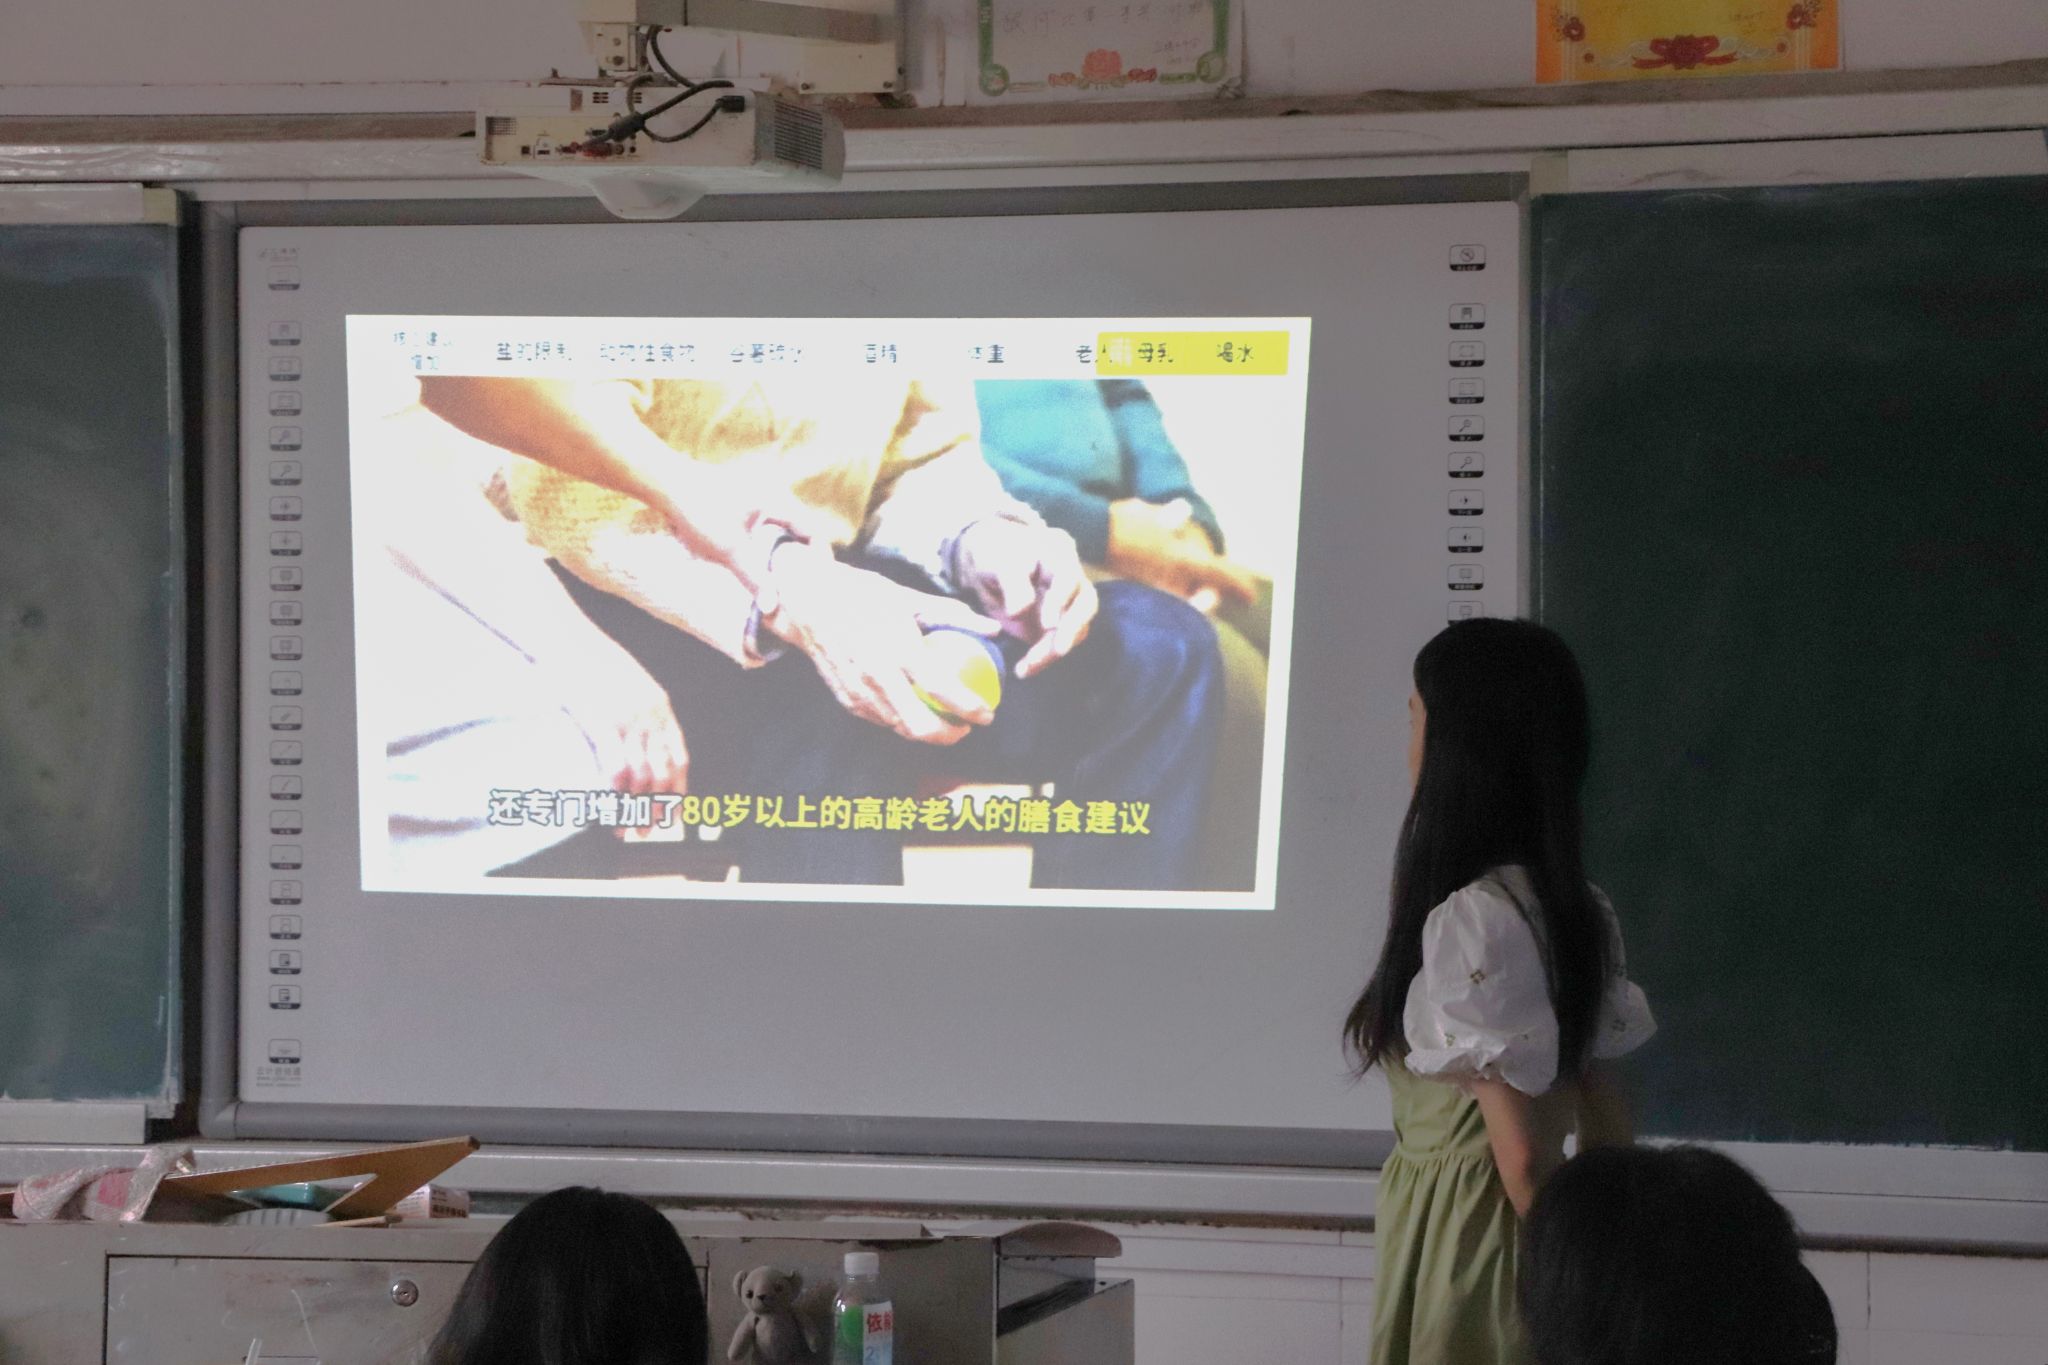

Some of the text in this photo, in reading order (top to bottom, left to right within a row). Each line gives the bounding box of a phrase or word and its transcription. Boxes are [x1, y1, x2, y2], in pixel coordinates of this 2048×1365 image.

[488, 788, 1151, 835] 还专门增加了80岁以上的高龄老人的膳食建议
